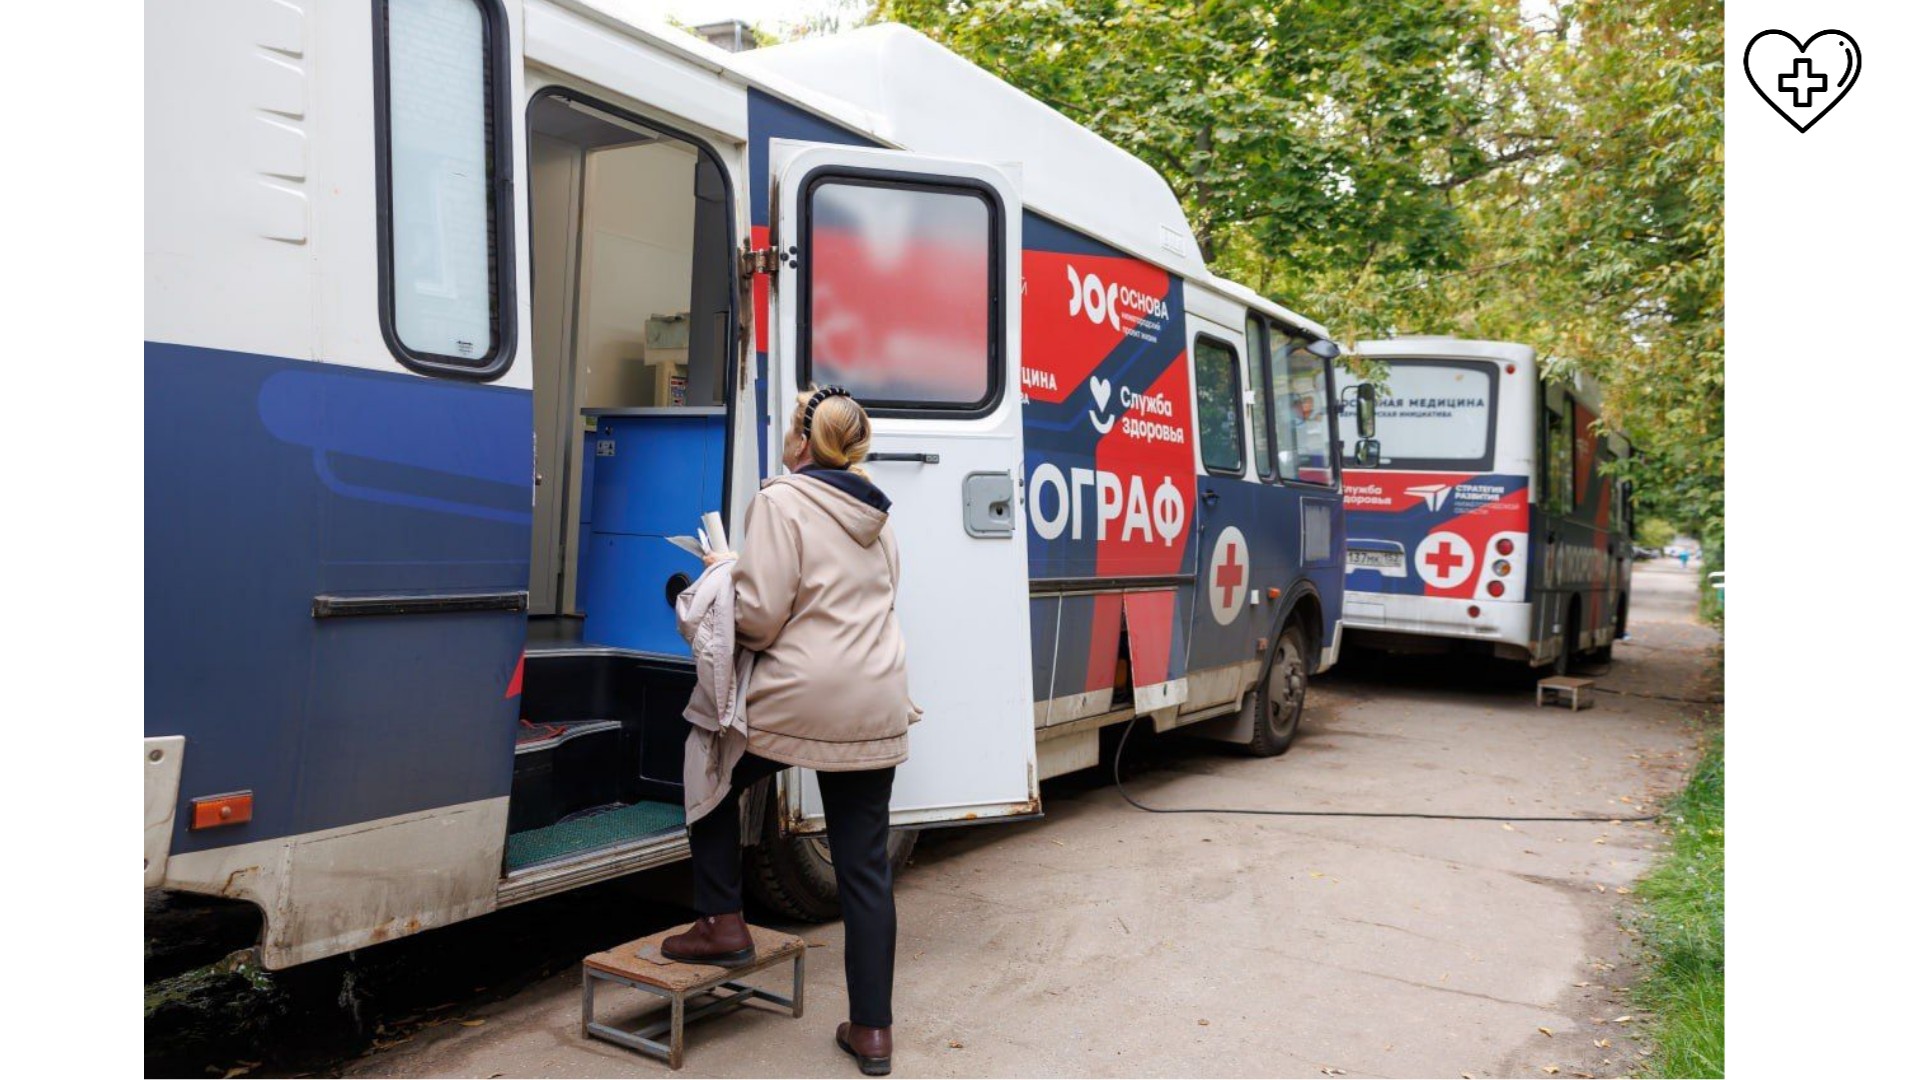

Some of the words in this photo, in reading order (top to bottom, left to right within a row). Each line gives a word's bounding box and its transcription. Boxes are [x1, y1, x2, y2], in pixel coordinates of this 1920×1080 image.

[1120, 286, 1170, 320] ОСНОВА
[1120, 385, 1172, 417] Служба
[1409, 398, 1485, 409] МЕДИЦИНА
[1122, 417, 1184, 443] здоровья
[1028, 462, 1185, 547] ОГРАФ
